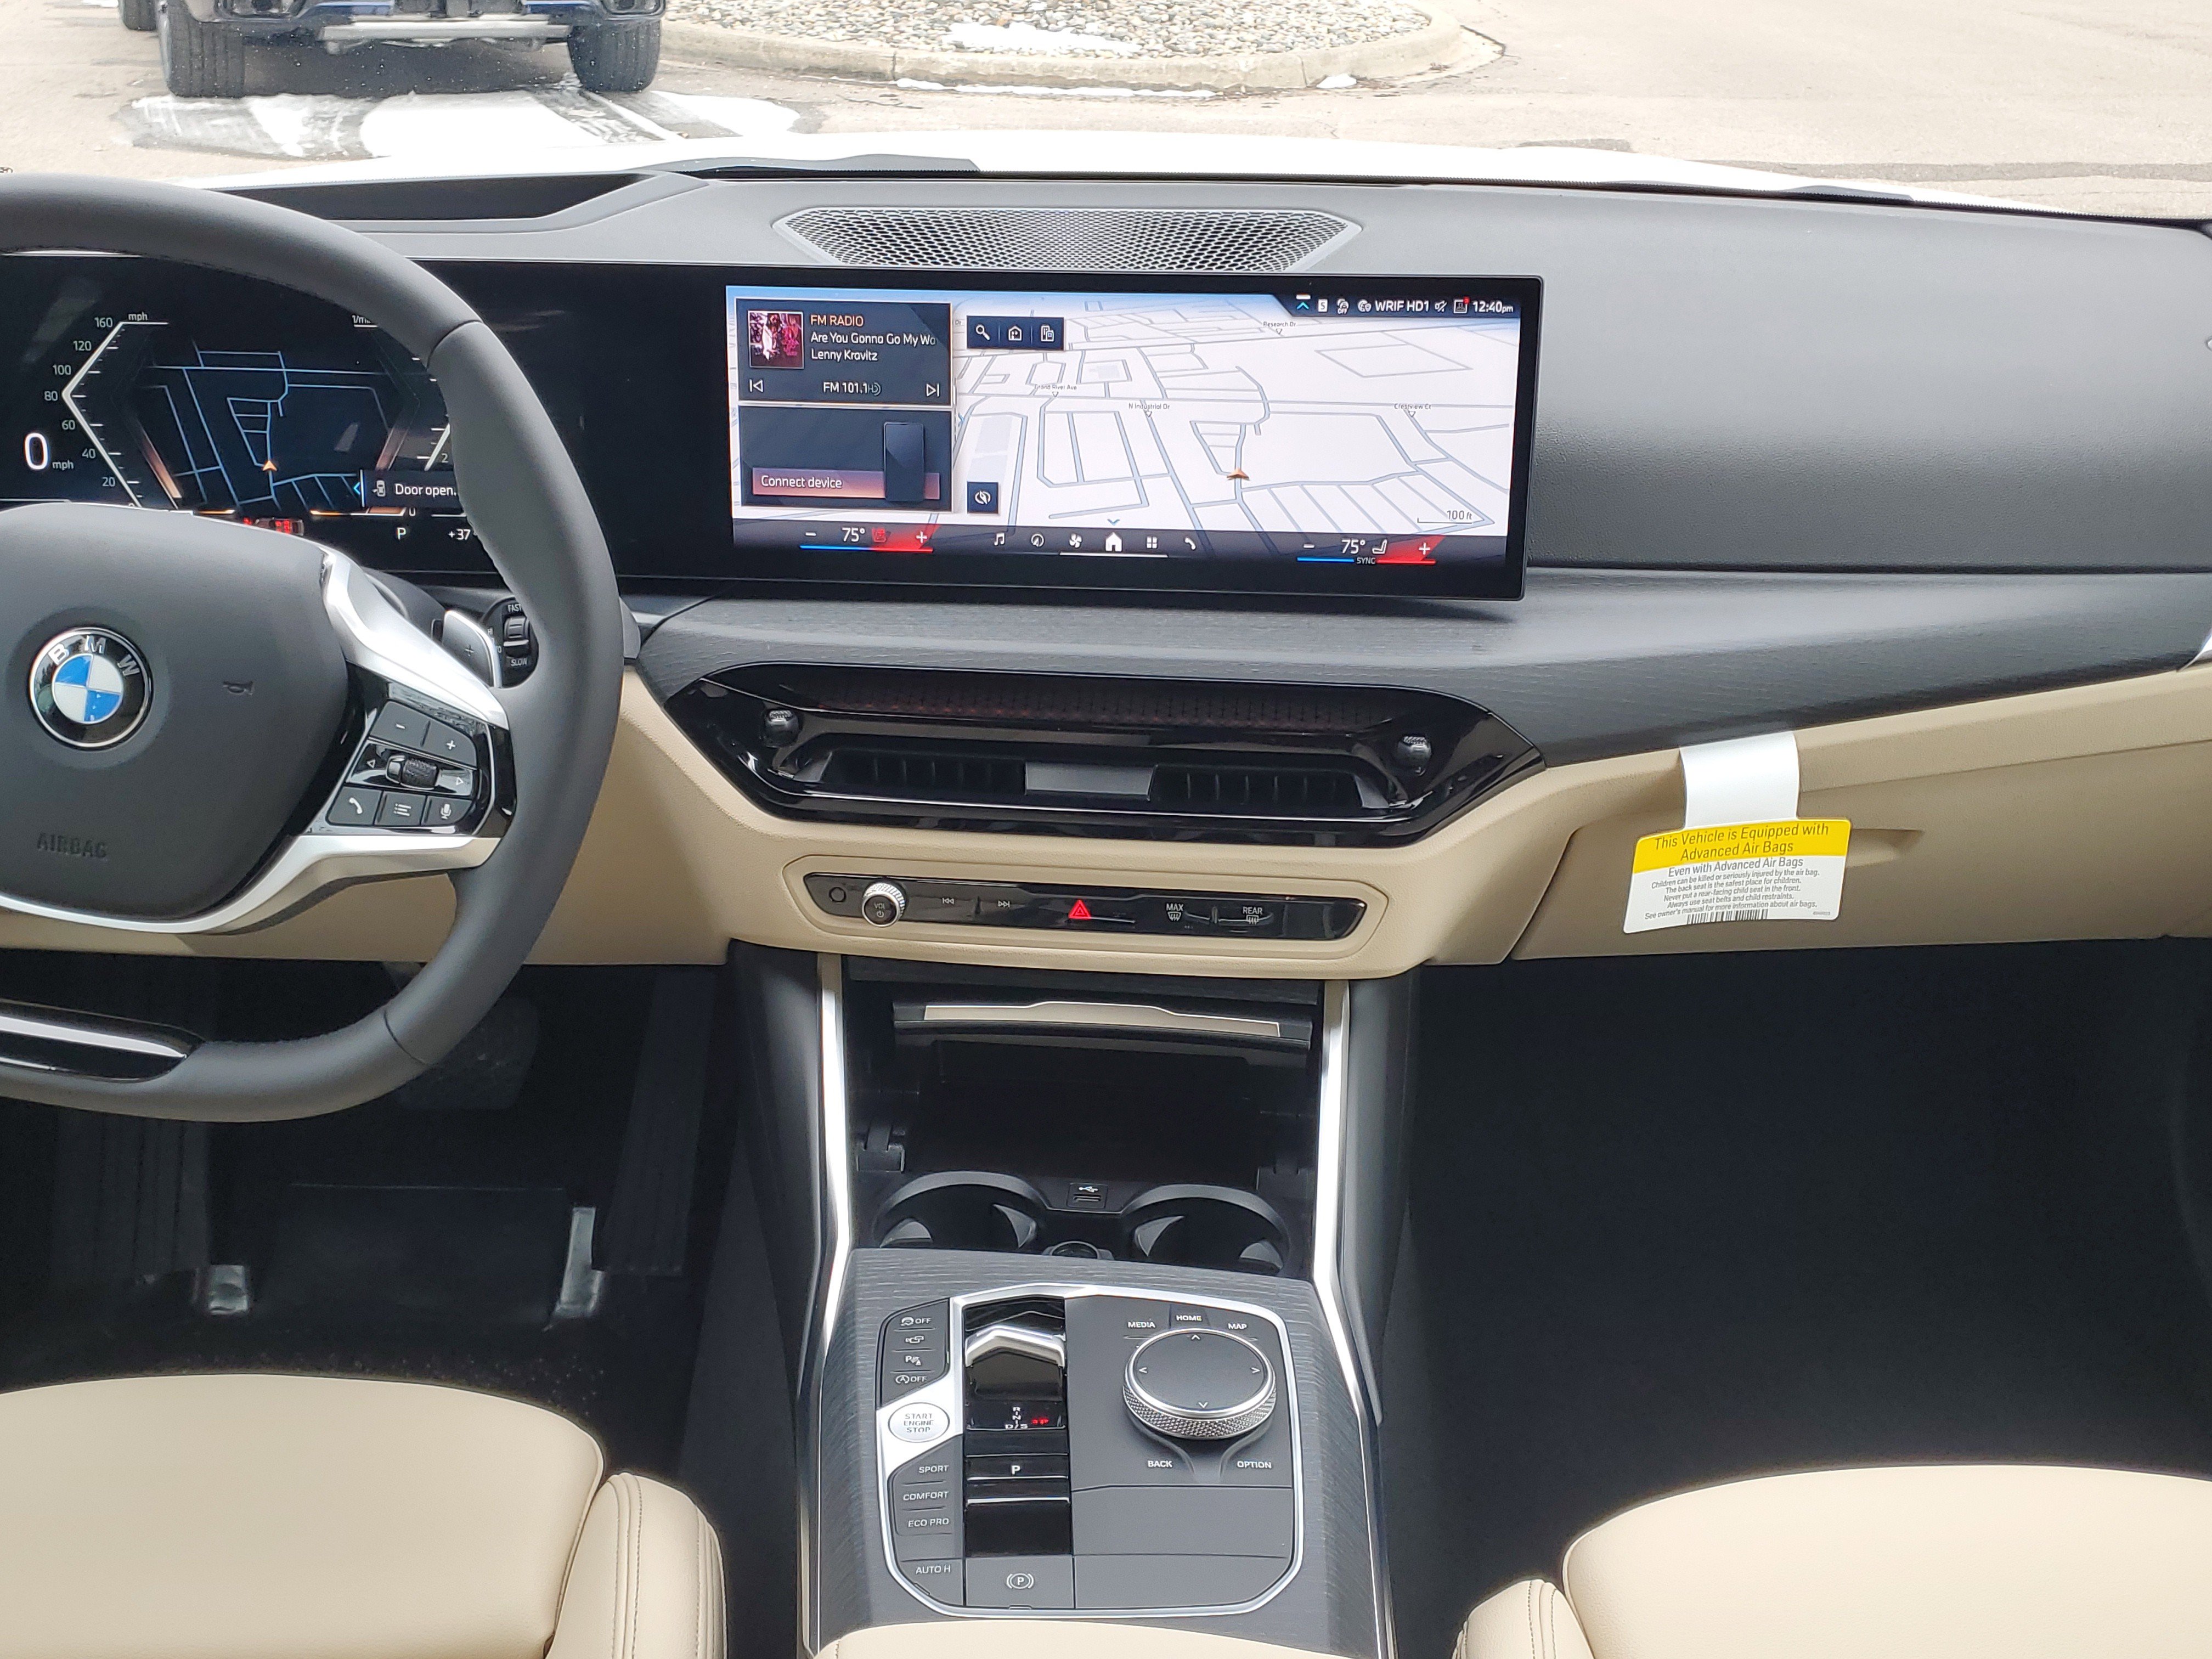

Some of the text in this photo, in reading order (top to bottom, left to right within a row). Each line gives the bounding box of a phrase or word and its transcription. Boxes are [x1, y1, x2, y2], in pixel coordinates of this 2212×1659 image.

[1375, 300, 1429, 312] WRIF HD1
[1473, 301, 1514, 314] 12:40pm
[128, 312, 148, 321] mph
[810, 314, 864, 327] FM RADIO
[94, 317, 113, 328] 160
[811, 331, 938, 347] Are You Gonna Go My Wa
[73, 341, 92, 351] 120
[811, 348, 878, 362] Lenny Kravitz
[53, 364, 71, 375] 100
[823, 382, 839, 393] FM
[842, 382, 867, 394] 101.1
[44, 391, 58, 401] 80
[61, 420, 75, 430] 60
[25, 432, 74, 471] 0 mph
[82, 448, 96, 459] 40
[441, 453, 449, 463] 2
[102, 477, 116, 487] 20
[761, 475, 843, 488] Connect device
[394, 483, 457, 498] Door open.
[1447, 510, 1472, 520] 100 ft
[397, 527, 407, 540] P
[842, 527, 866, 543] 75°
[1341, 539, 1365, 554] 75°
[507, 603, 522, 613] FAST
[48, 635, 140, 676] BMW
[511, 658, 528, 667] SLOW
[1655, 823, 1829, 850] This Vehicle is Equipped with
[37, 832, 107, 858] AIRBAG
[1680, 840, 1793, 861] Advanced Air Bags
[1668, 857, 1803, 877] Even with Advanced Air Bags
[1652, 880, 1675, 889] Children
[1723, 871, 1751, 879] seriously
[1752, 870, 1774, 879] injured
[1725, 879, 1744, 887] safest
[1745, 878, 1762, 886] place
[1663, 894, 1681, 902] Never
[1698, 888, 1732, 898] rear-facing
[1166, 903, 1184, 911] MAX
[1657, 908, 1681, 918] owner's
[1681, 905, 1705, 914] manual
[1733, 901, 1769, 909] information
[1799, 900, 1818, 909] bags.
[1667, 900, 1688, 909] Always
[1243, 906, 1263, 915] REAR
[918, 1465, 949, 1474] SPORT
[1011, 1465, 1020, 1475] P
[1237, 1460, 1272, 1469] OPTION
[903, 1491, 949, 1501] COMFORT
[908, 1517, 950, 1527] ECO PRO
[916, 1565, 951, 1575] AUTO H
